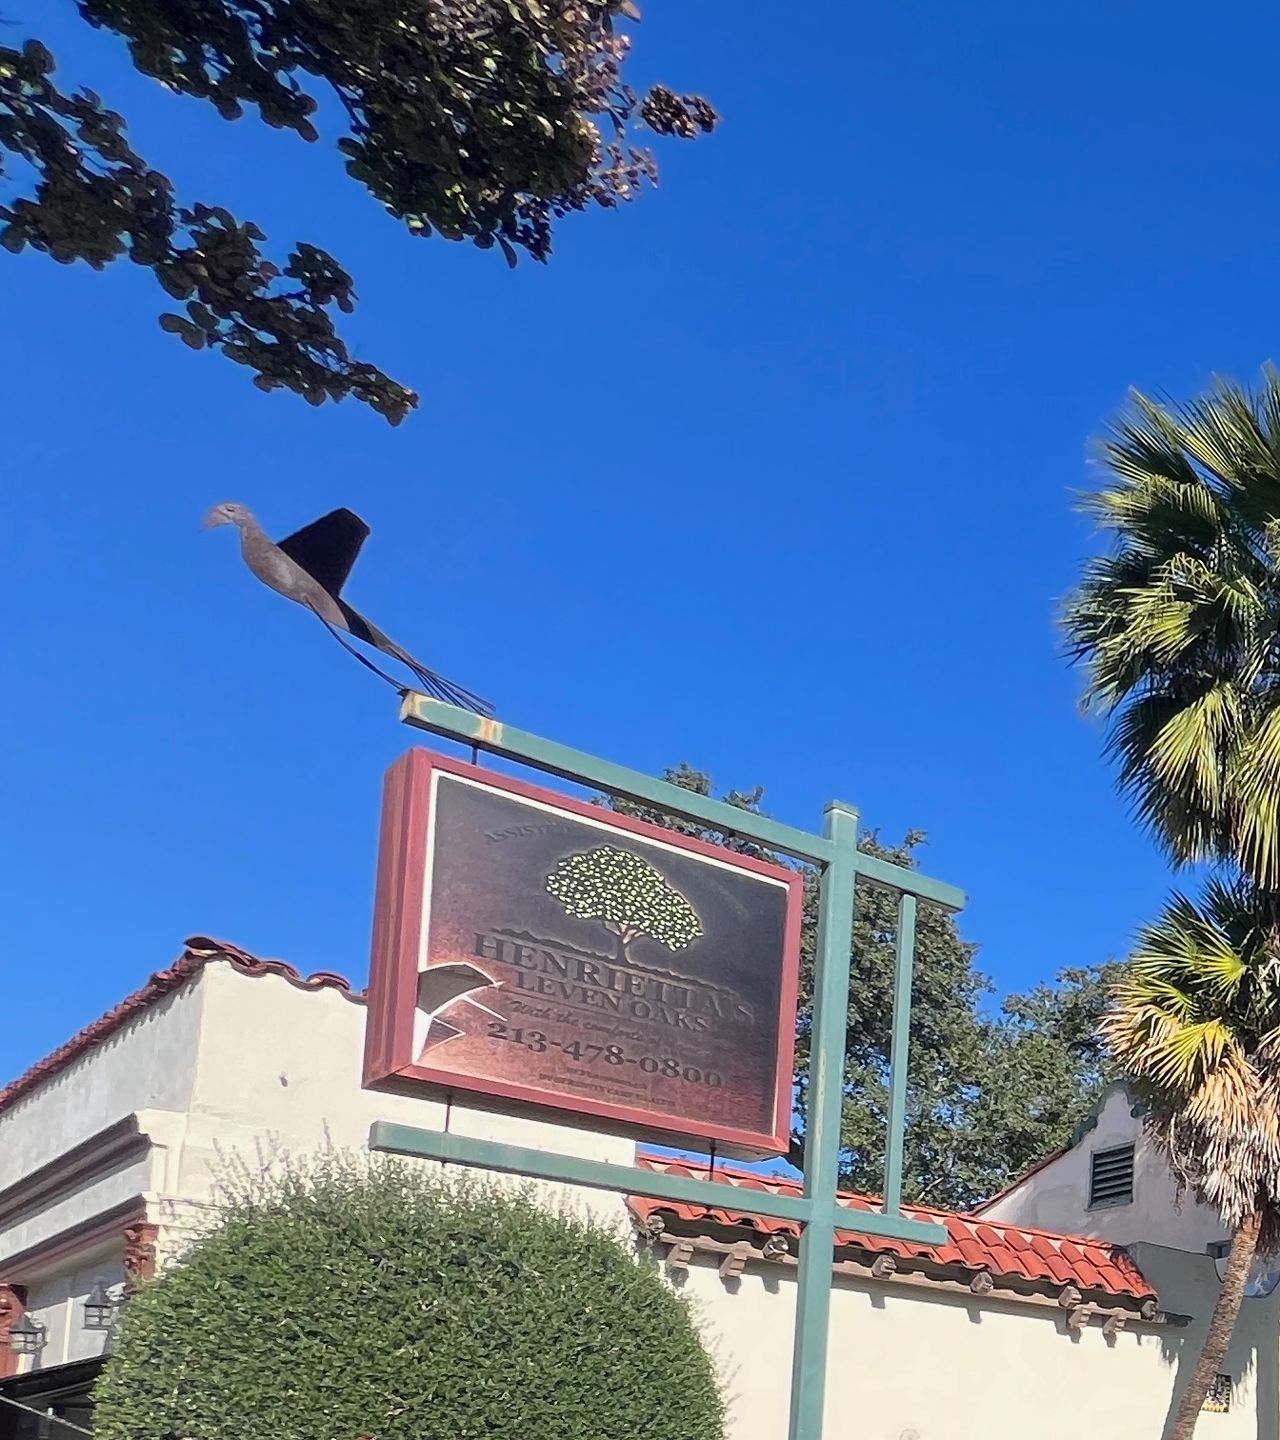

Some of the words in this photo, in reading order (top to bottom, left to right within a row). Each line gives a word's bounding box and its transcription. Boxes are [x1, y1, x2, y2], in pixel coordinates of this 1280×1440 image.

[473, 932, 755, 1025] HENRIETTA'S
[514, 972, 622, 1012] LEVEN
[629, 1001, 711, 1032] OAKS
[486, 1022, 724, 1087] 213-478-0800
